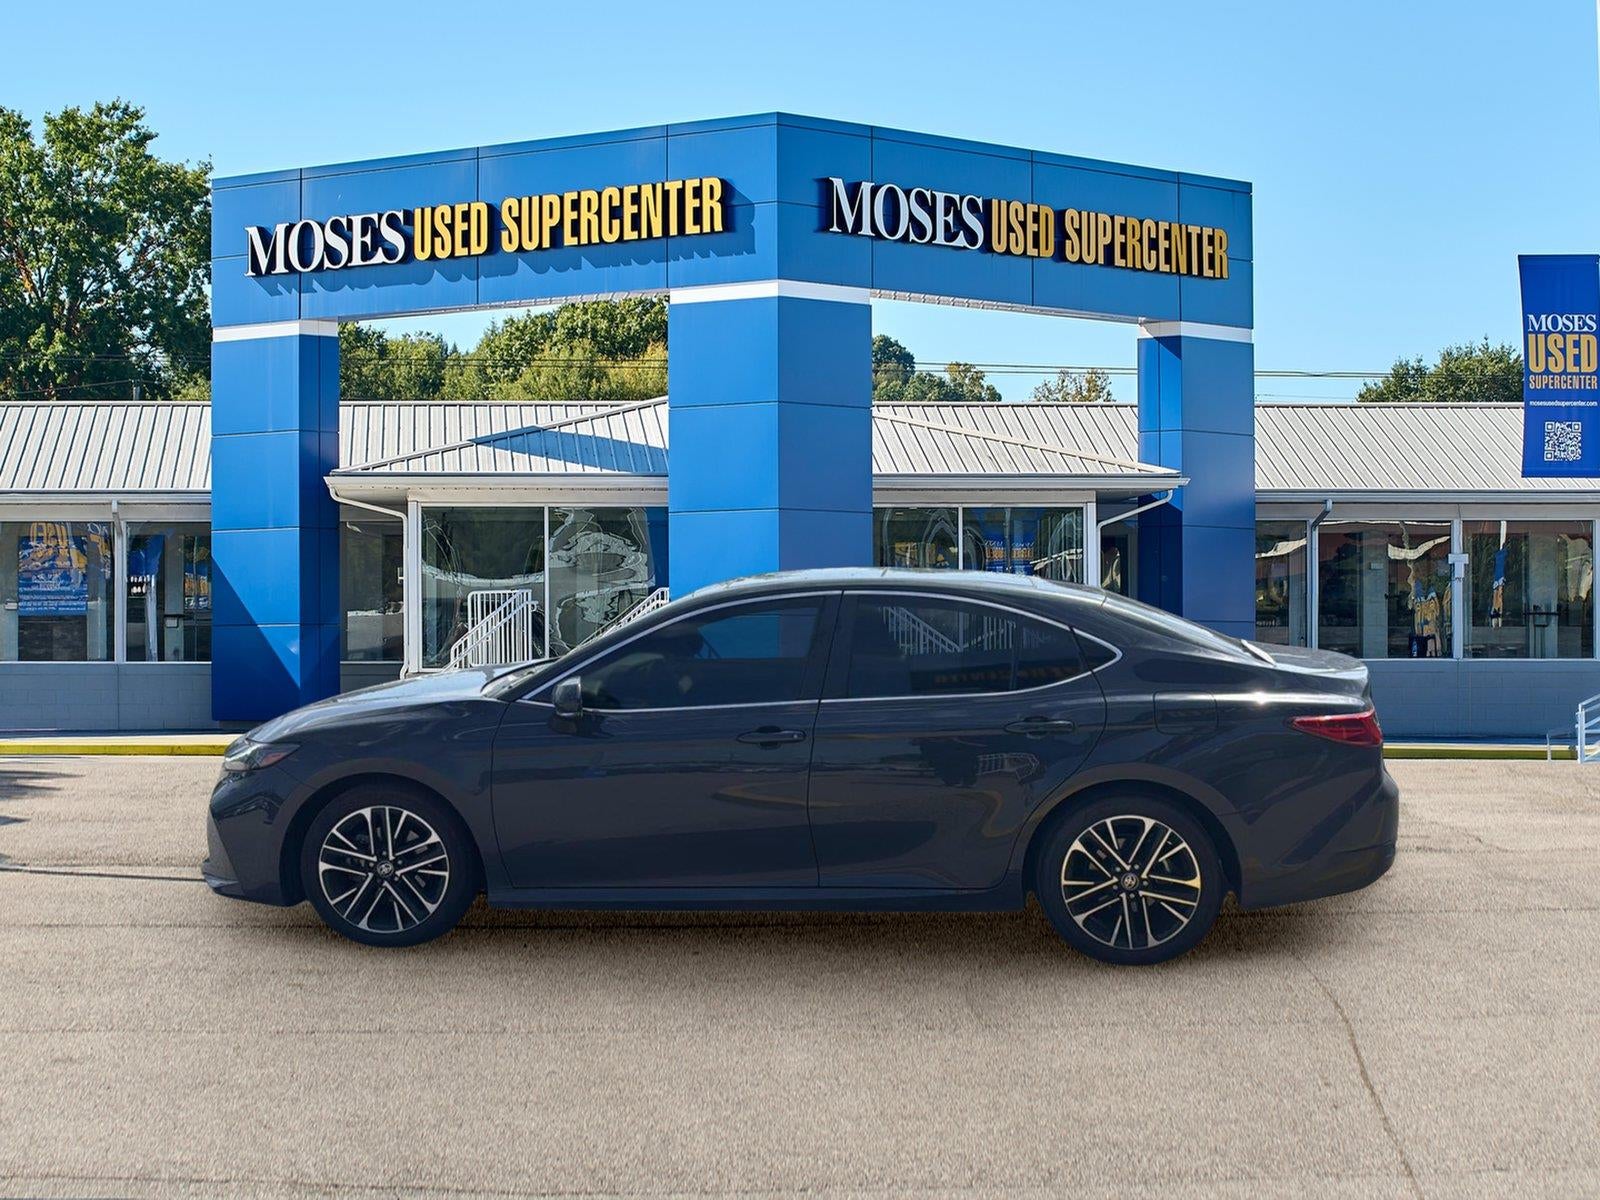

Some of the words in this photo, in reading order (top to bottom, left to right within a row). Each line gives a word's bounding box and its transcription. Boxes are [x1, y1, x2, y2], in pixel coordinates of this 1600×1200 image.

[244, 209, 406, 277] MOSES
[413, 201, 489, 261] USED
[500, 176, 724, 253] SUPERCENTER
[829, 176, 985, 250] MOSES
[991, 198, 1055, 258] USED
[1064, 207, 1230, 279] SUPERCENTER
[1527, 313, 1597, 333] MOSES
[1528, 333, 1598, 373] USED
[1529, 375, 1598, 389] SUPERCENTER
